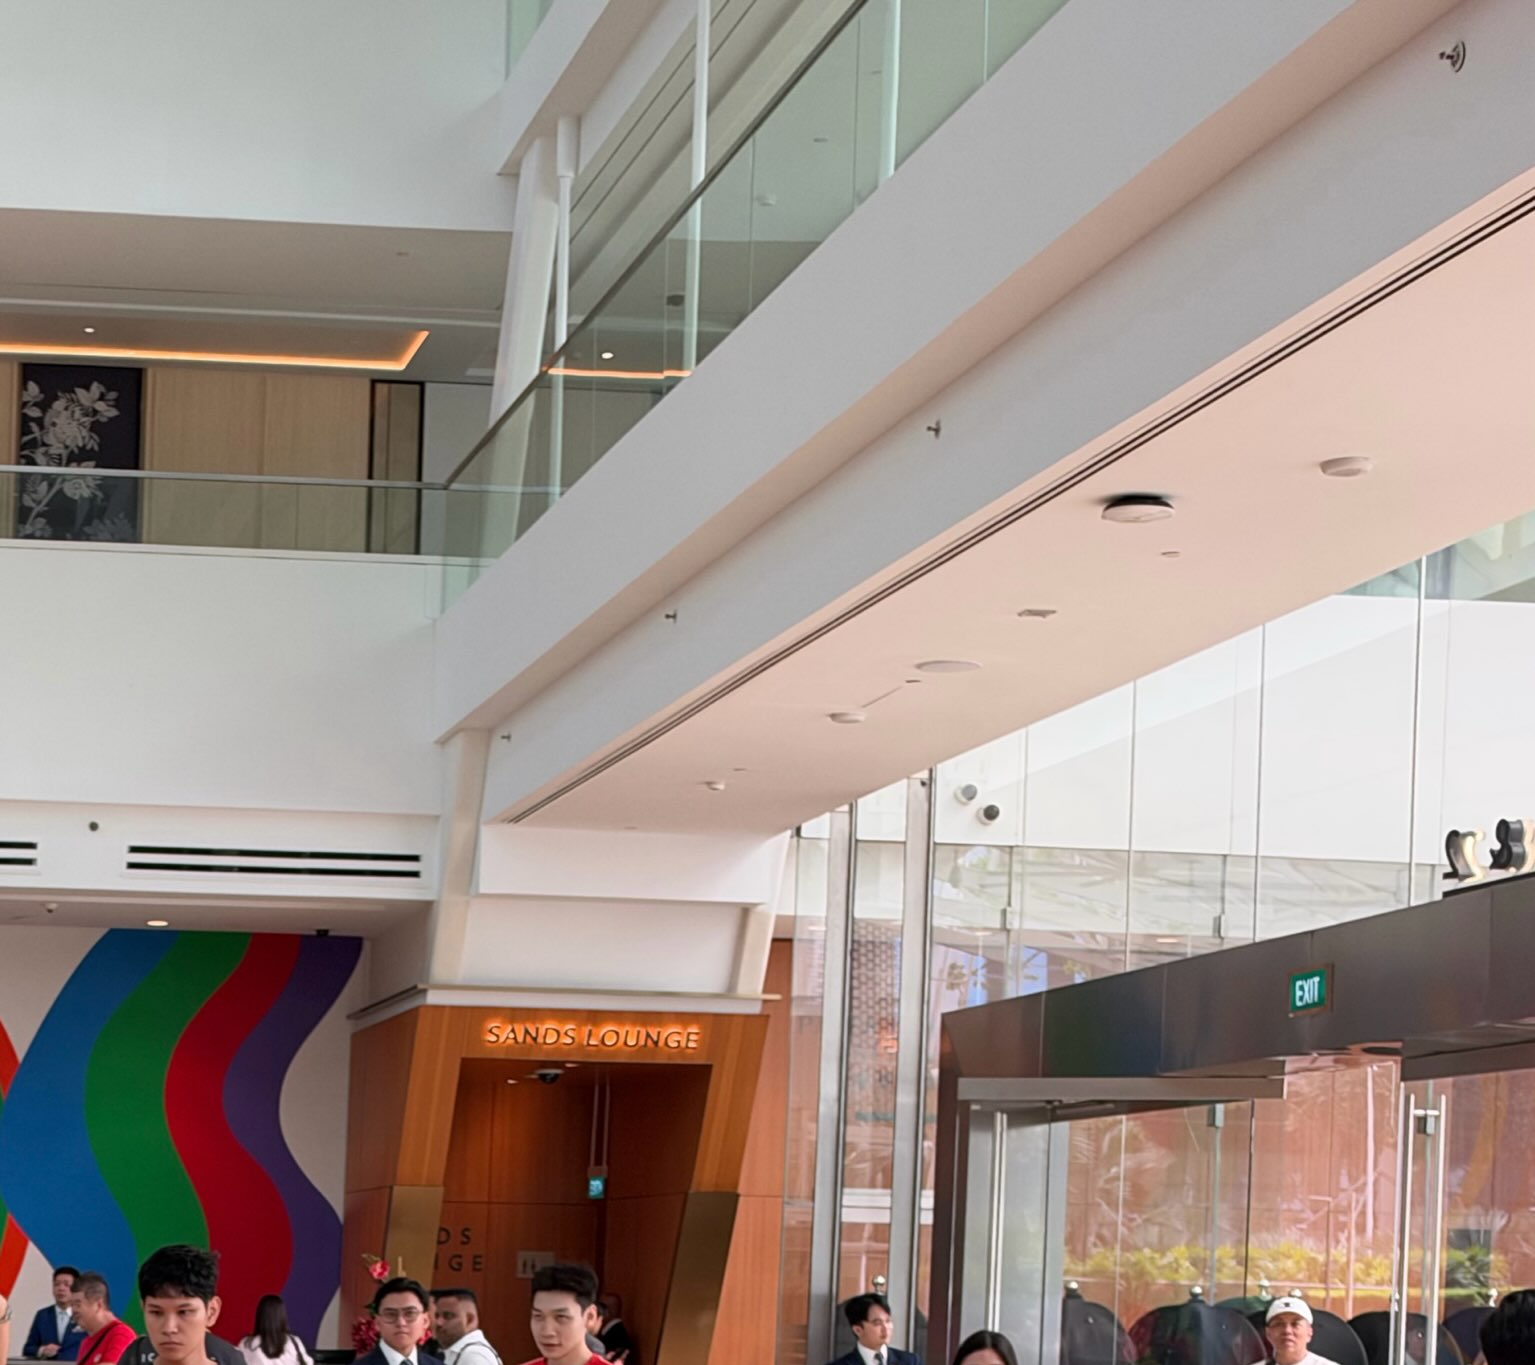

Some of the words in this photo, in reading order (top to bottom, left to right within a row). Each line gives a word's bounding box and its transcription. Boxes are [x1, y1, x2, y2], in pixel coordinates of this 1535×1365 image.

[1295, 976, 1320, 1007] EXIT
[487, 1025, 576, 1046] SANDS
[586, 1029, 702, 1050] LOUNGE
